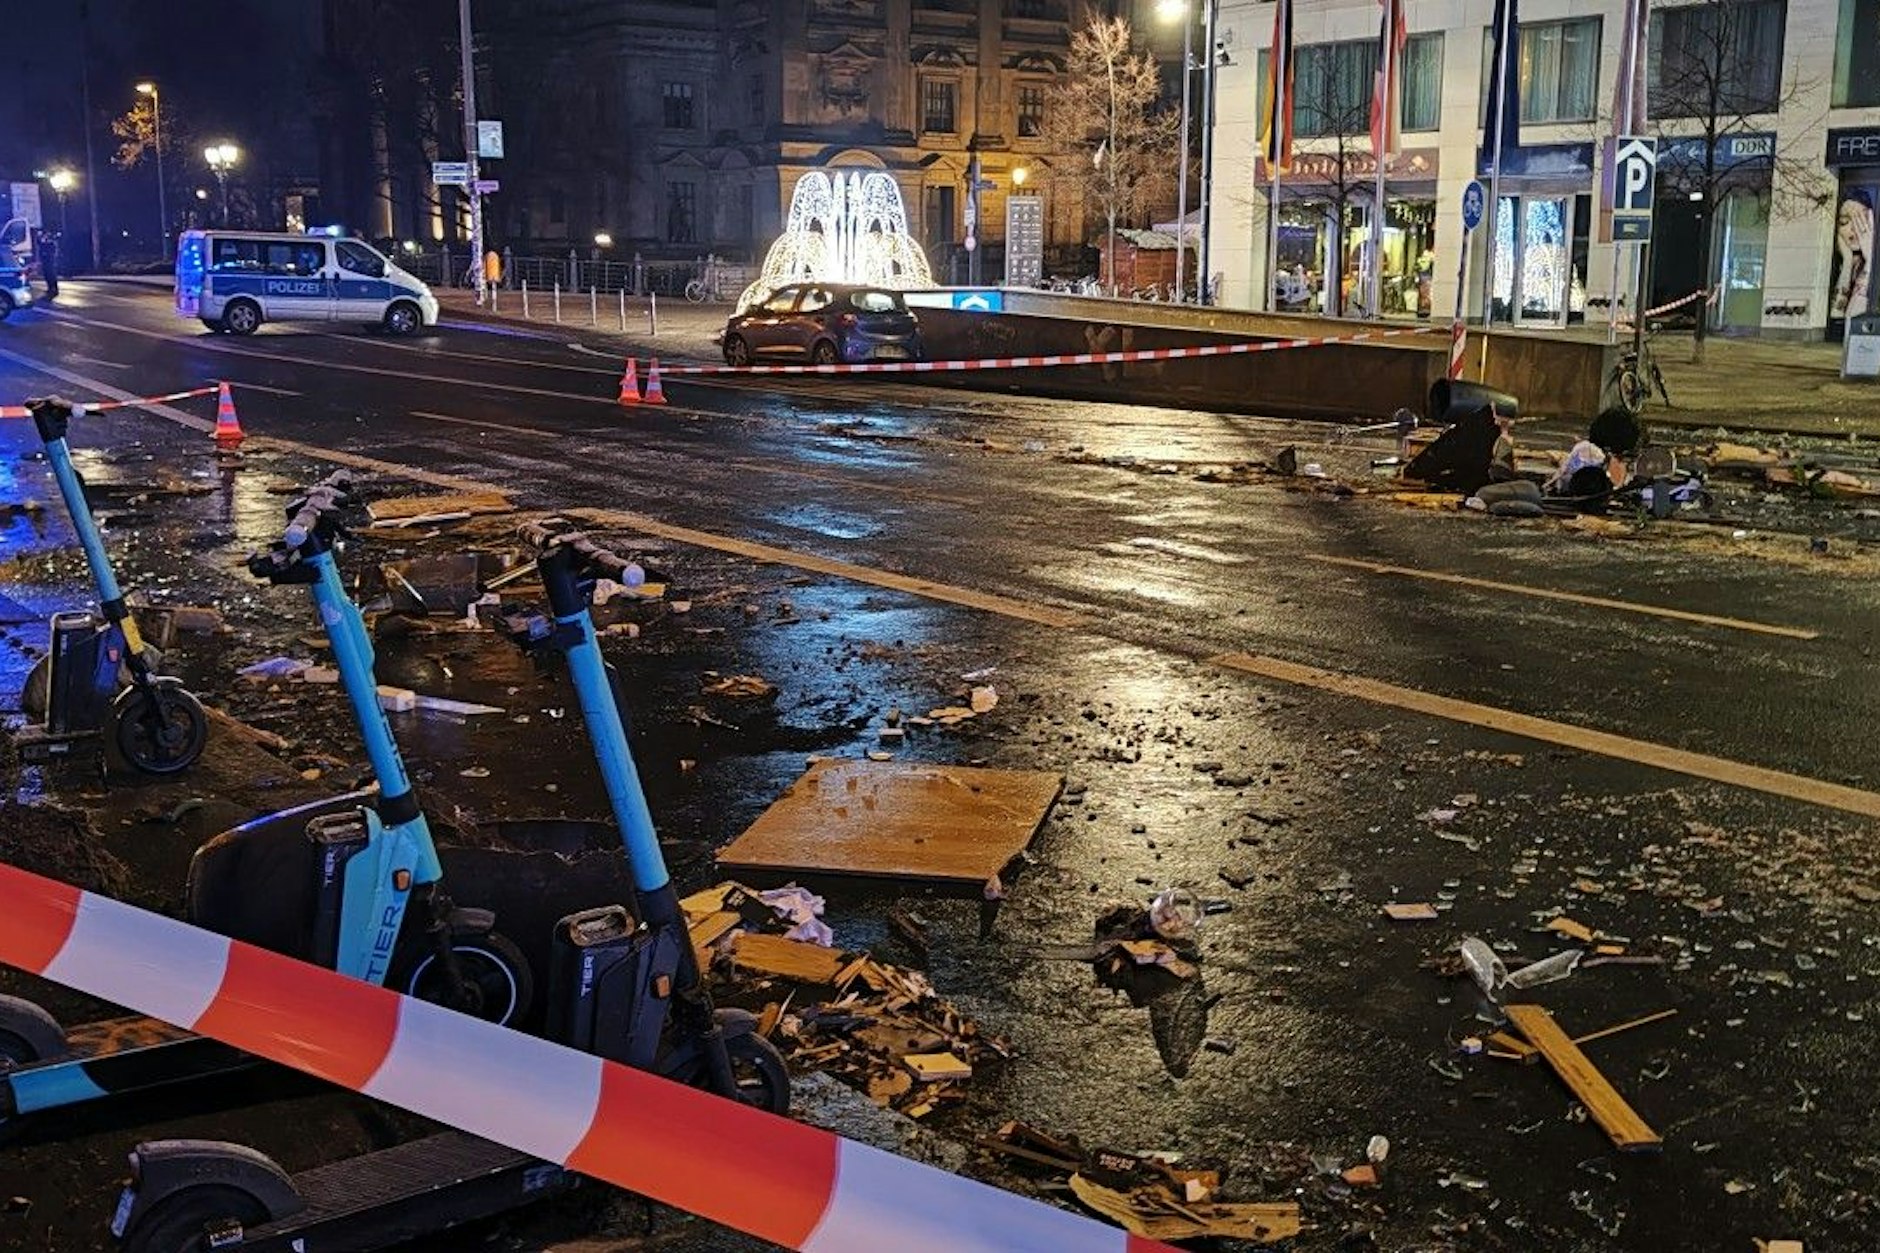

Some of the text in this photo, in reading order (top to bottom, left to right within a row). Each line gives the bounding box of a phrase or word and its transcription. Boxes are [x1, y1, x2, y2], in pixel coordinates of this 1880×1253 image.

[1735, 139, 1767, 153] DDR
[1624, 157, 1648, 210] P
[268, 280, 320, 293] POLIZEI
[324, 850, 336, 887] TIER
[366, 905, 402, 981] TIER
[580, 955, 595, 997] TIER
